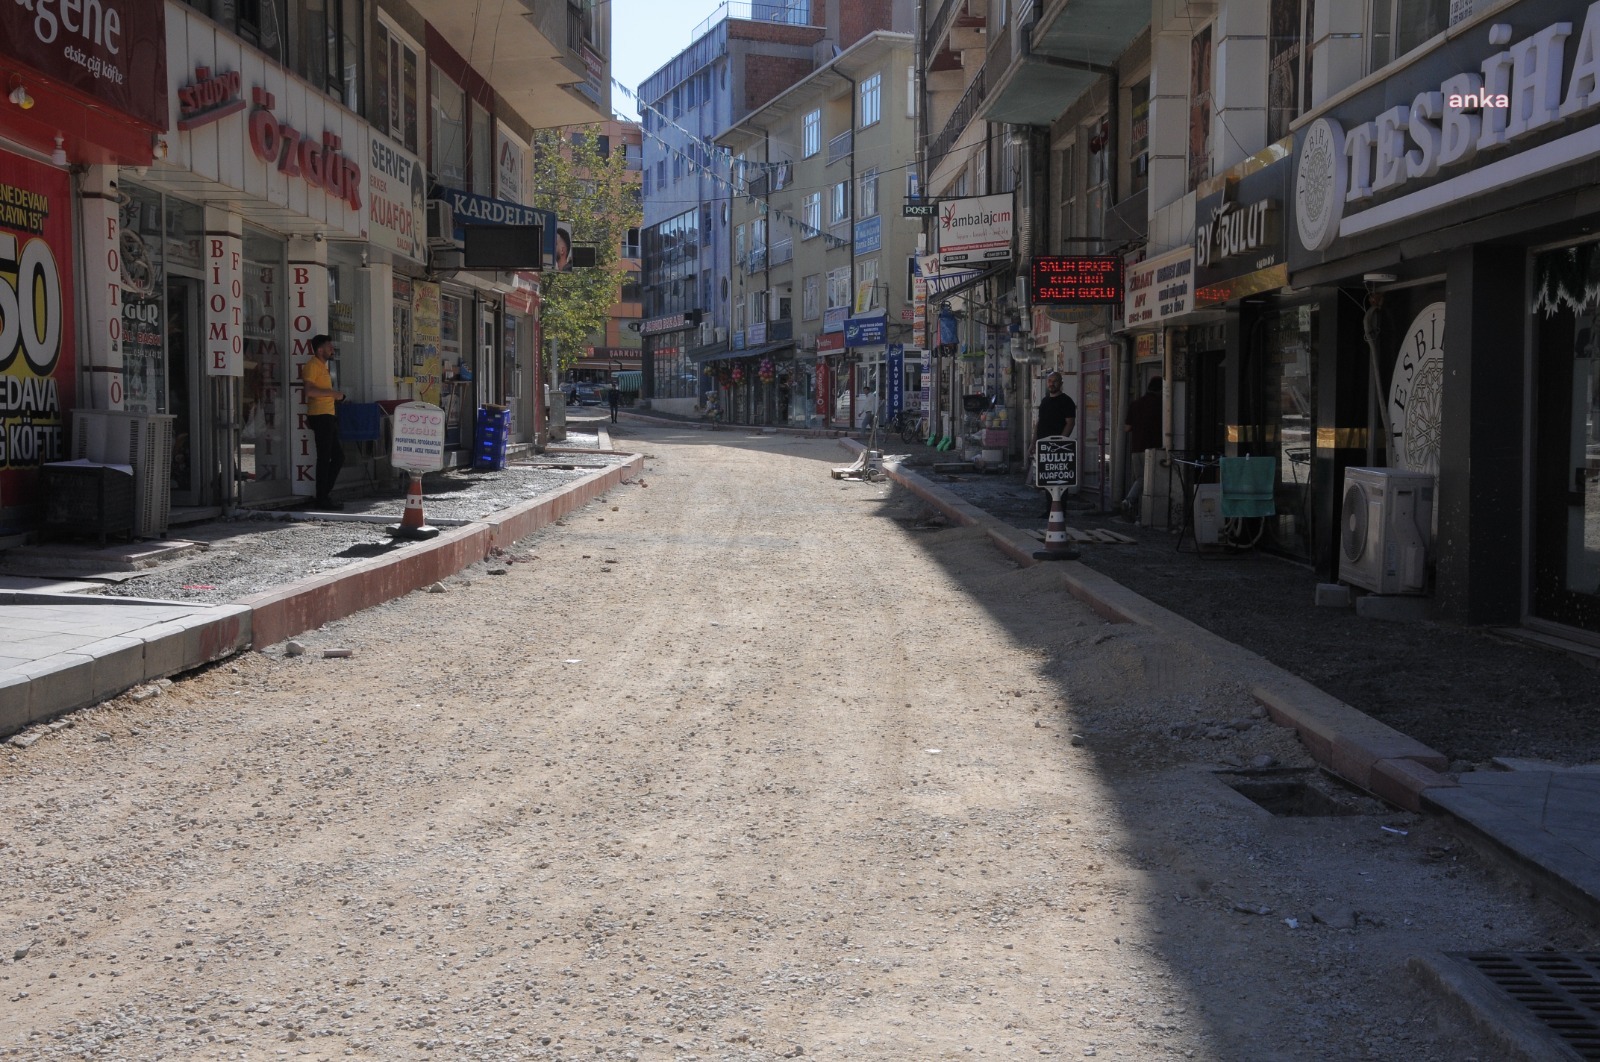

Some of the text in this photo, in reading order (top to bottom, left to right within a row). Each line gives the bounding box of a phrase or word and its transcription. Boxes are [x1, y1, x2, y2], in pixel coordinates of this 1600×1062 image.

[64, 45, 123, 85] etsiz çiğ köfte
[249, 86, 362, 211] ÖZGÜR
[372, 138, 411, 187] SERVET
[15, 187, 48, 213] DEVAM
[370, 174, 387, 194] ERKEK
[6, 205, 27, 227] AYIN
[370, 192, 413, 239] KUAFÖR
[454, 194, 547, 231] KARDELEN
[1197, 223, 1214, 268] BY
[1221, 199, 1269, 259] BULUT
[107, 217, 120, 341] FOTO
[1078, 261, 1115, 272] ERKEK
[209, 239, 229, 370] BİOME
[231, 251, 242, 354] FOTO
[1392, 313, 1445, 448] TESBİ
[399, 413, 441, 425] FOTO
[401, 424, 437, 436] ÖZGÜR
[10, 417, 63, 460] KÖFTE
[1040, 444, 1051, 452] By
[1039, 453, 1075, 463] BULUT
[1039, 470, 1075, 480] KUAFÖRÜ
[1045, 463, 1068, 471] ERKEK
